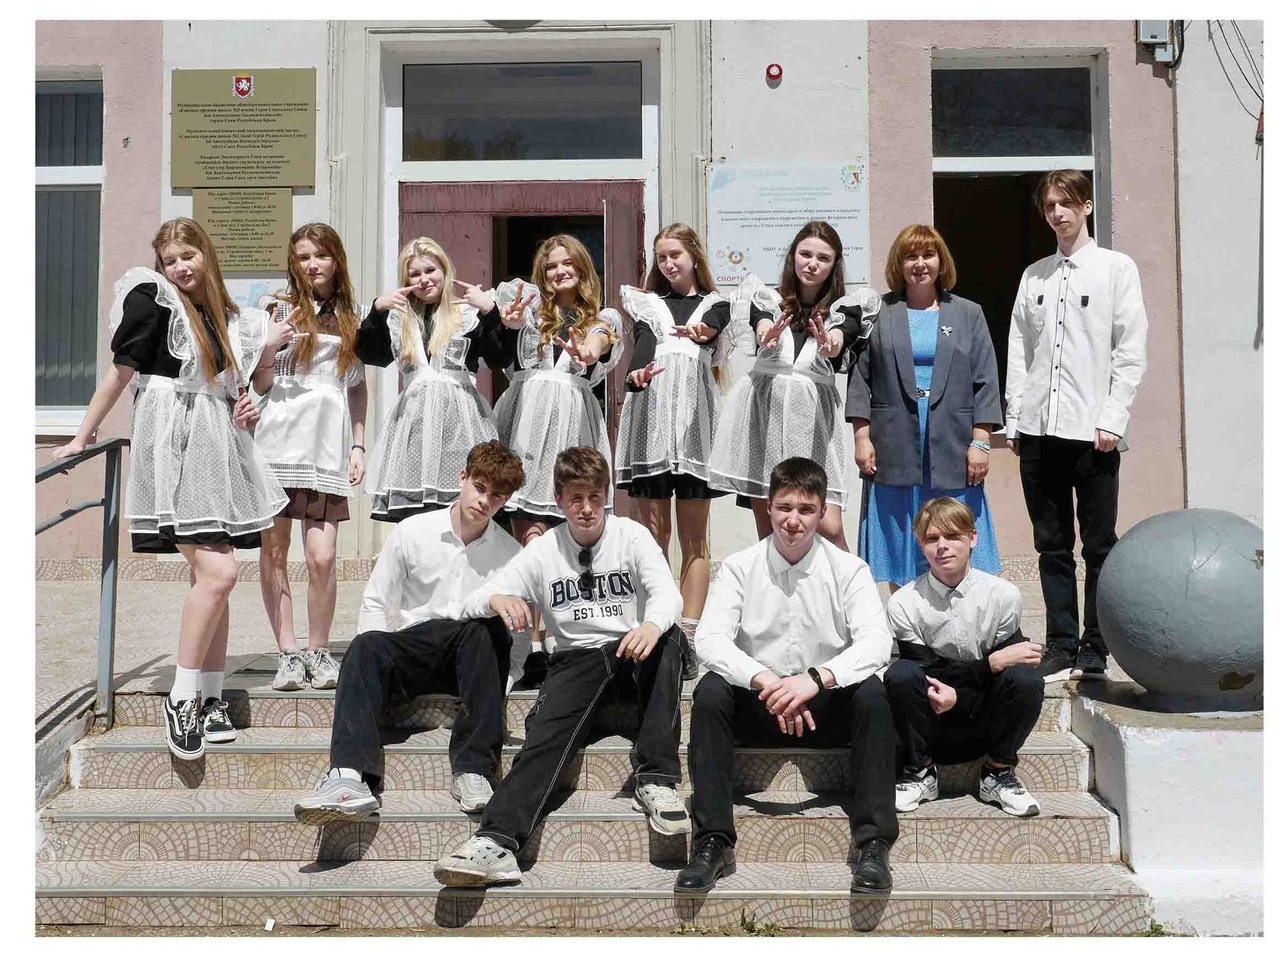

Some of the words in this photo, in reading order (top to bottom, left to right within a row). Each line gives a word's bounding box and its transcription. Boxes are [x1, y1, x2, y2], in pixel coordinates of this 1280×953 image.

[551, 571, 635, 609] BOSTON
[573, 607, 599, 621] EST.
[601, 604, 623, 618] 1990
